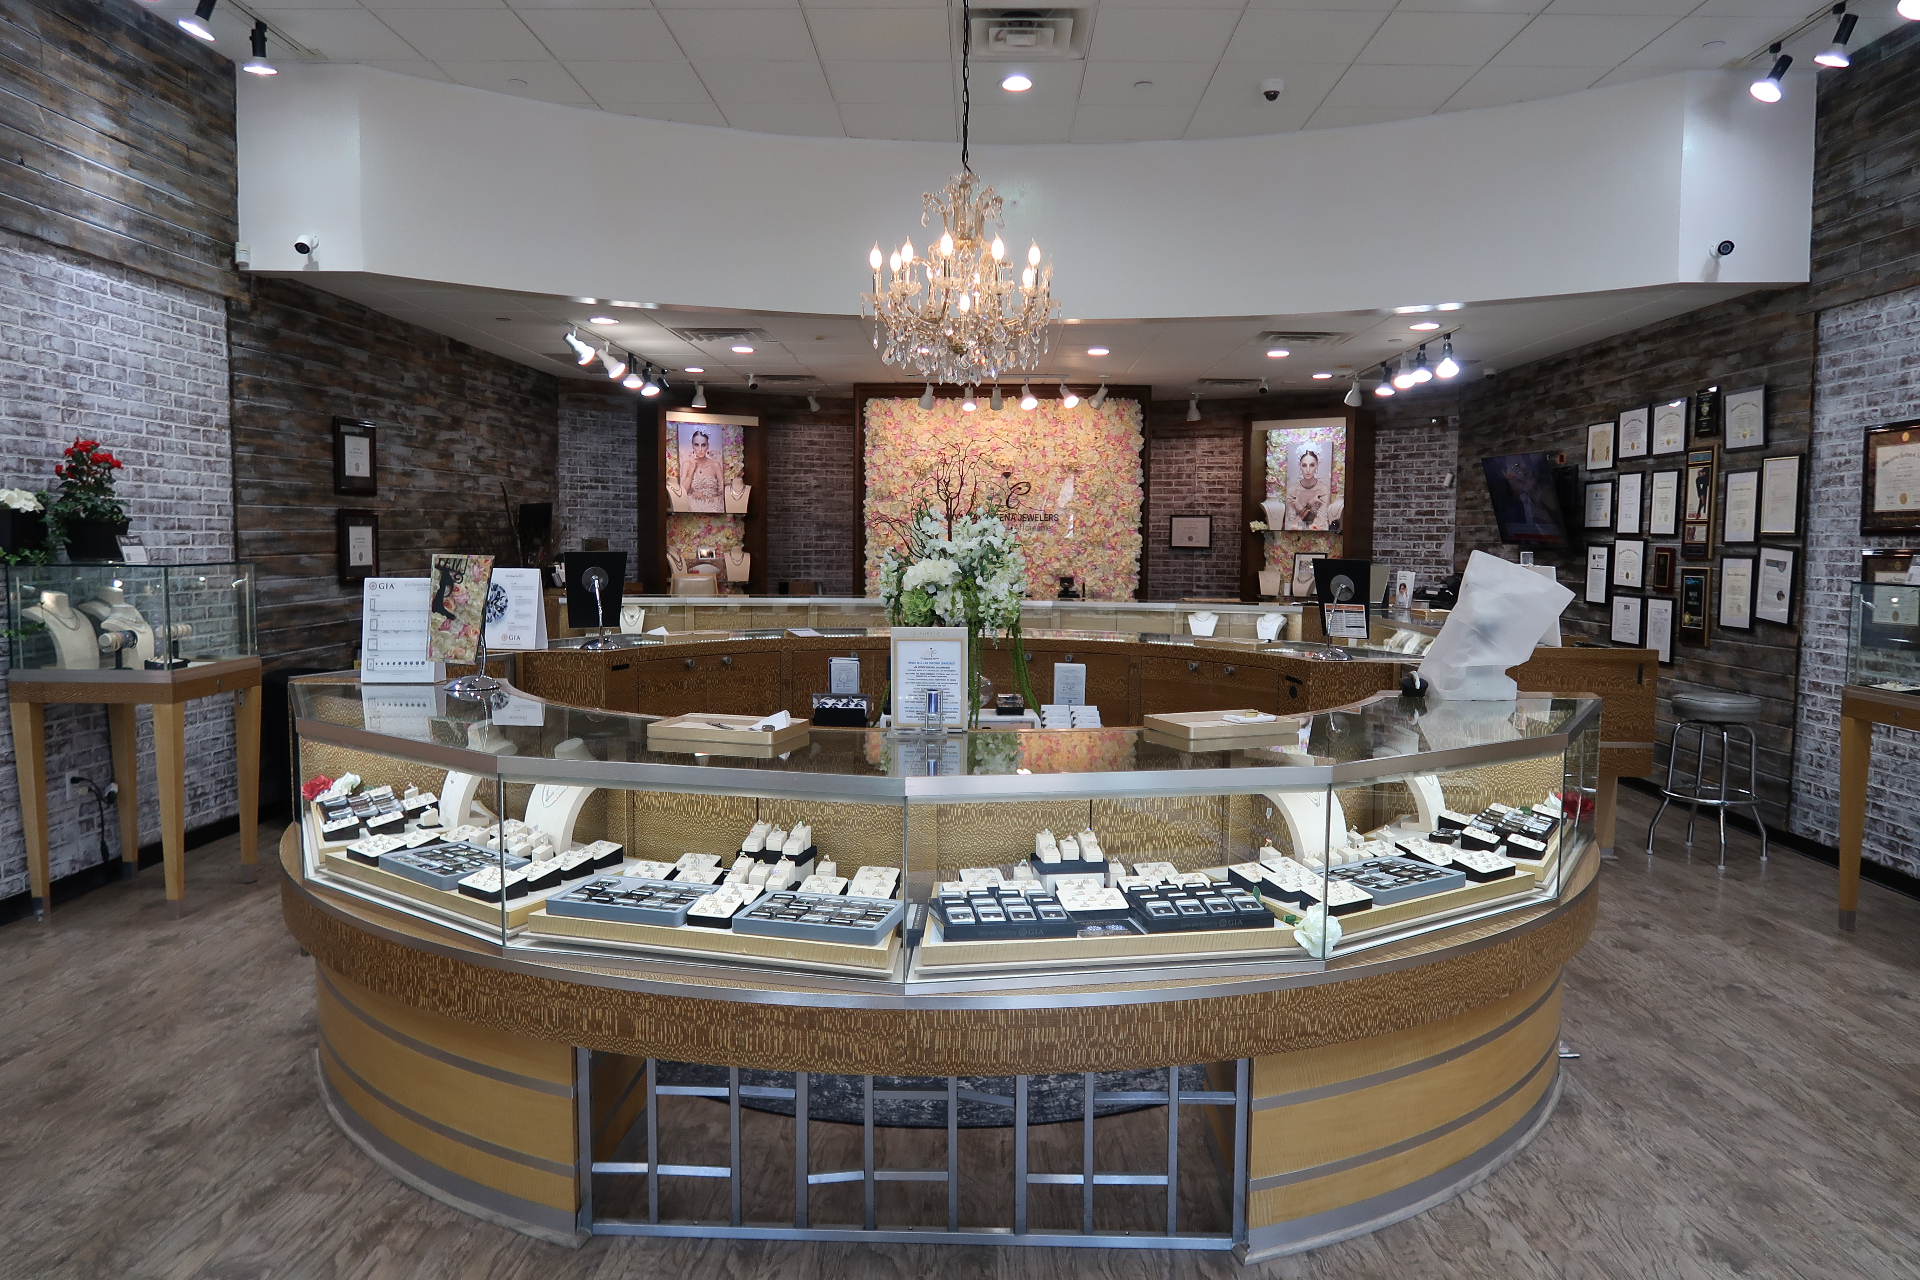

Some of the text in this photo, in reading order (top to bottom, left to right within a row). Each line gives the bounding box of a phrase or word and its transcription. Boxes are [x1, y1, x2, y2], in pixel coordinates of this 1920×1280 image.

[1017, 513, 1060, 522] JEWELERS
[378, 582, 395, 590] GIA
[1028, 928, 1044, 936] GIA
